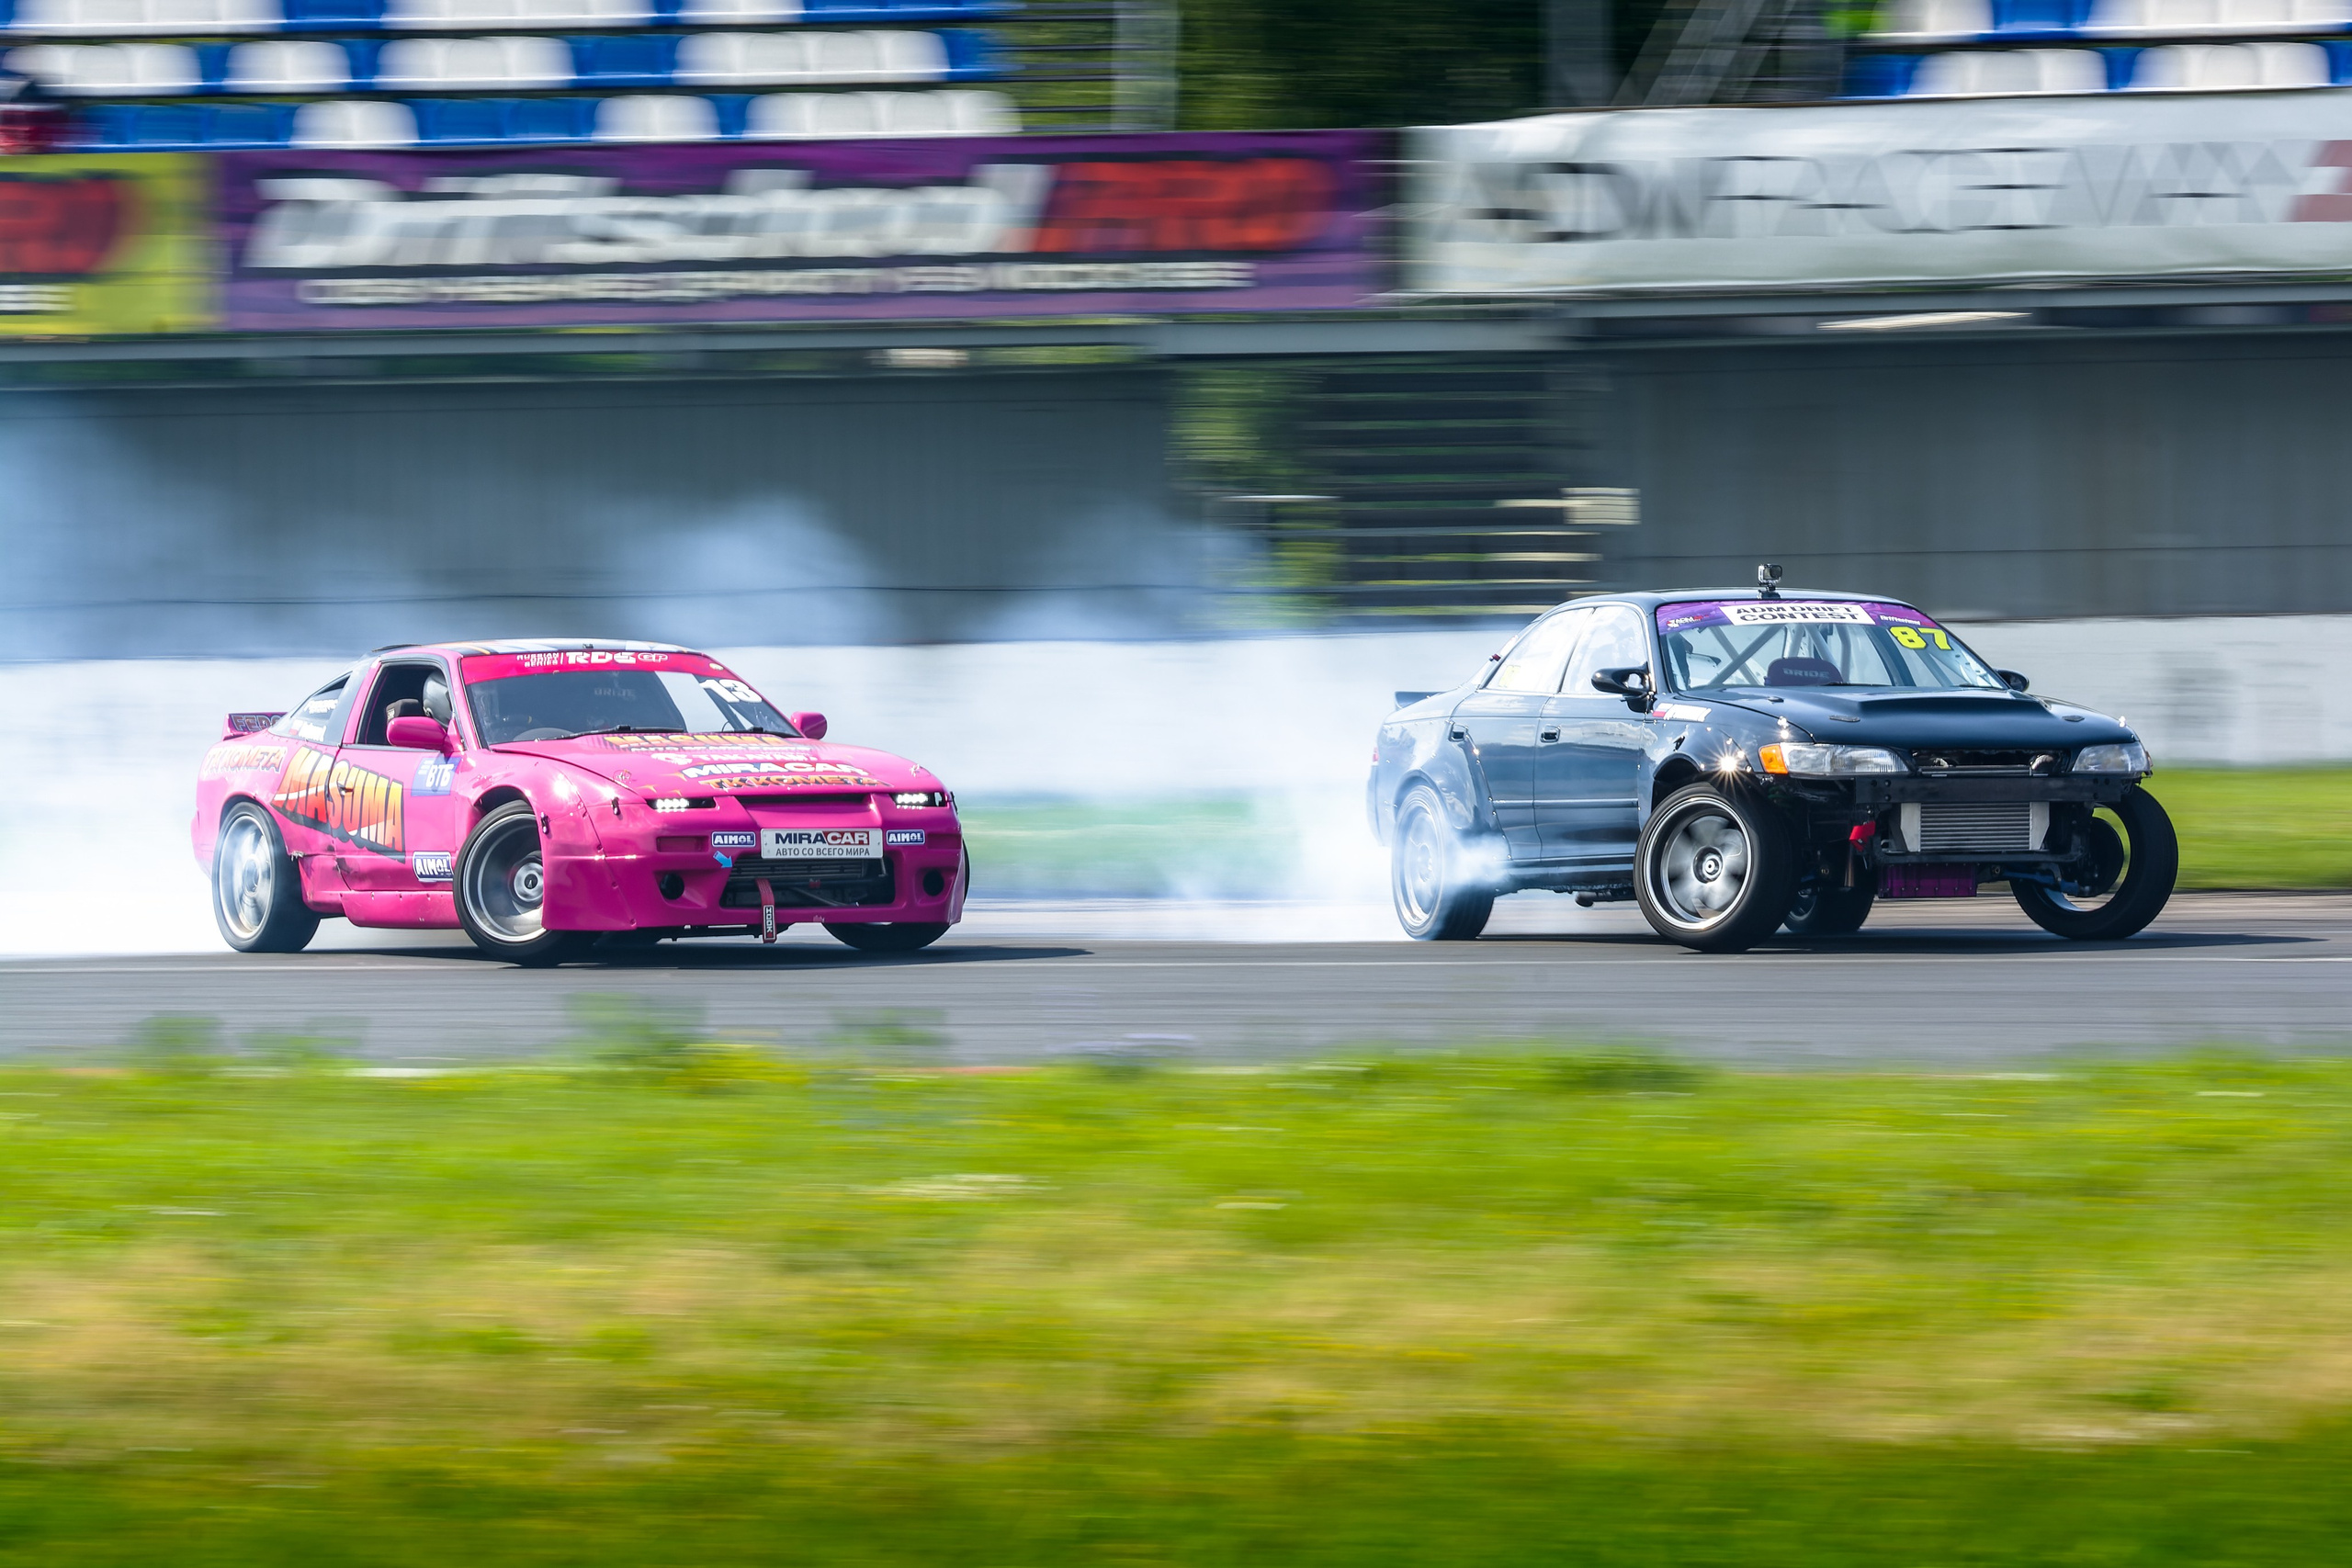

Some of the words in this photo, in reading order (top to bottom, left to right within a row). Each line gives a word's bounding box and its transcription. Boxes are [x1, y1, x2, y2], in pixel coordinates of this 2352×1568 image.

[1736, 606, 1787, 615] ADM
[1740, 613, 1859, 621] CONTEST
[1889, 626, 1952, 650] 87
[566, 651, 637, 664] RDS
[1783, 668, 1830, 679] BRIDE
[699, 679, 763, 704] 13
[604, 734, 793, 749] MASUMA
[425, 763, 455, 788] ВТБ
[681, 761, 869, 779] MIRACAR
[270, 745, 405, 858] MASUMA
[714, 834, 753, 845] AIMOL
[775, 831, 869, 845] MIRACAR
[888, 832, 923, 843] AIMOL
[775, 847, 799, 856] АВТО
[801, 847, 814, 856] СО
[816, 847, 844, 856] ВСЕГО
[845, 847, 870, 856] МИРА
[415, 857, 451, 876] AIMOL
[765, 907, 774, 933] HOOK
